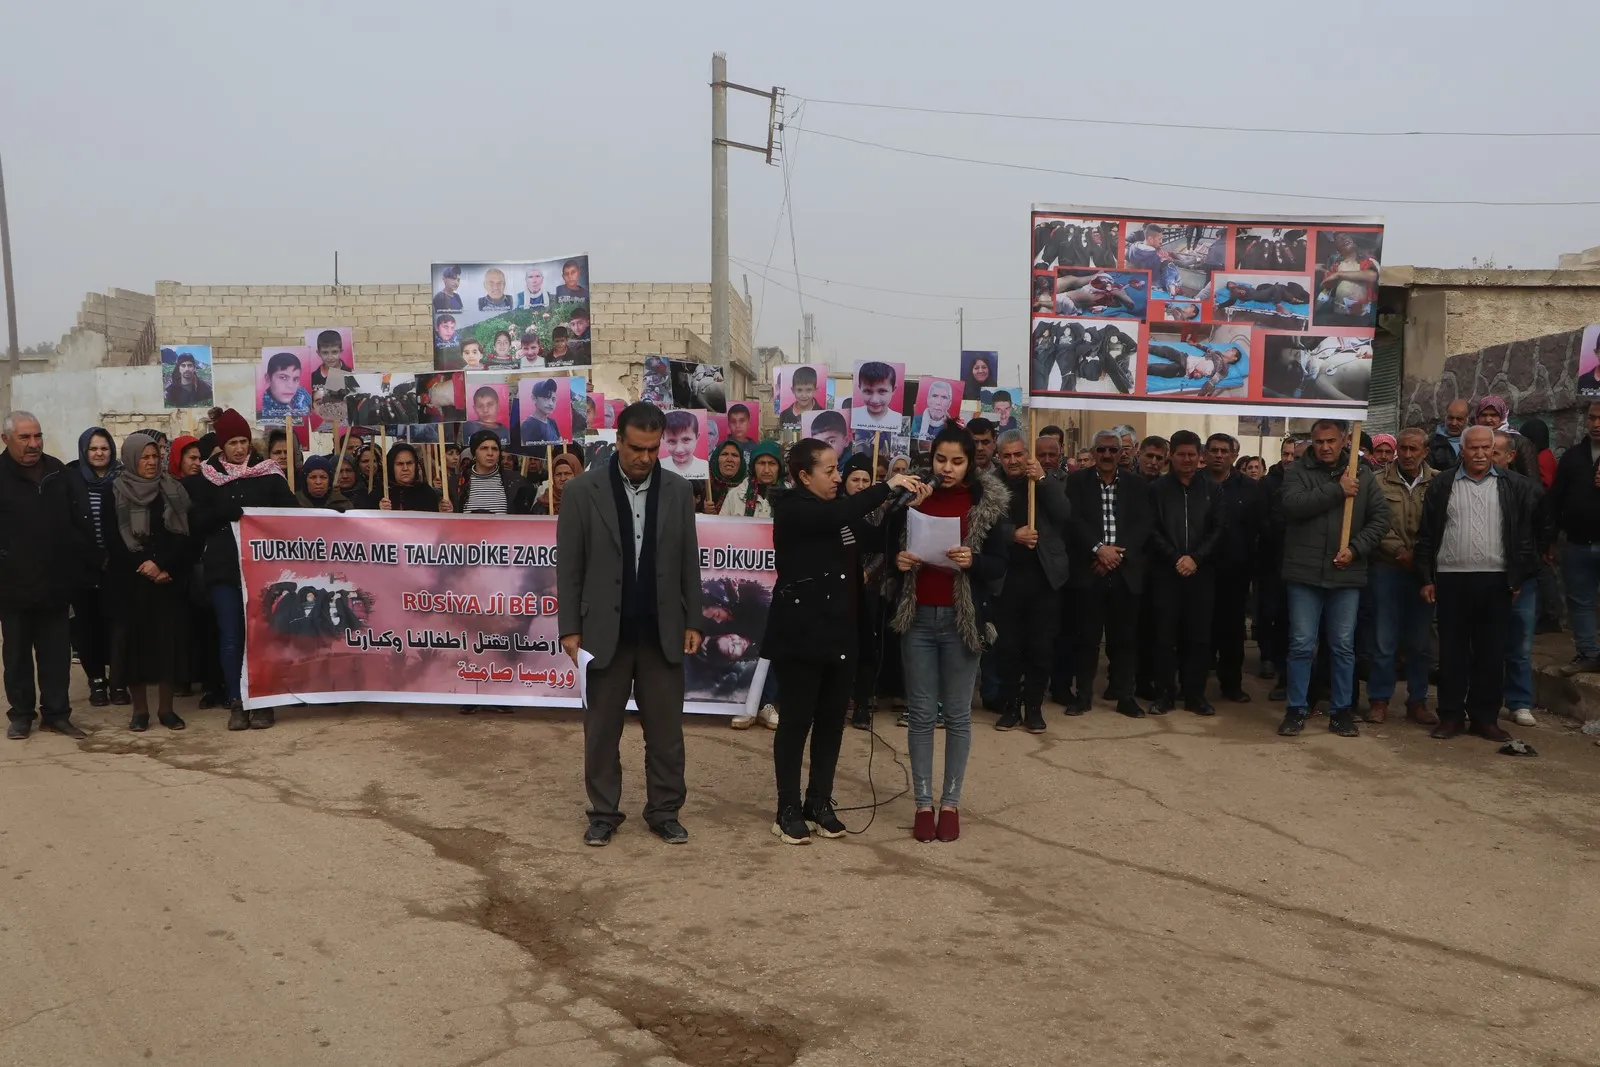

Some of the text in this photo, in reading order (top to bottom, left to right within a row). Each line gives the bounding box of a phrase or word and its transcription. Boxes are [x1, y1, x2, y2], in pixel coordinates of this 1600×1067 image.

[250, 537, 327, 561] TURKİYÊ
[330, 542, 368, 562] AXA
[371, 542, 398, 564] ME
[404, 543, 464, 566] TALAN
[468, 539, 509, 567] DİKE
[699, 547, 710, 569] E
[713, 543, 776, 571] DİKUJE
[402, 590, 481, 616] RÛSİYA
[485, 592, 504, 615] JÎ
[509, 591, 537, 616] BÊ
[345, 627, 403, 653] وكبارنا
[406, 628, 468, 651] أطفالنا
[473, 630, 511, 655] تقتل
[456, 660, 576, 689] وروسيا صامتة
